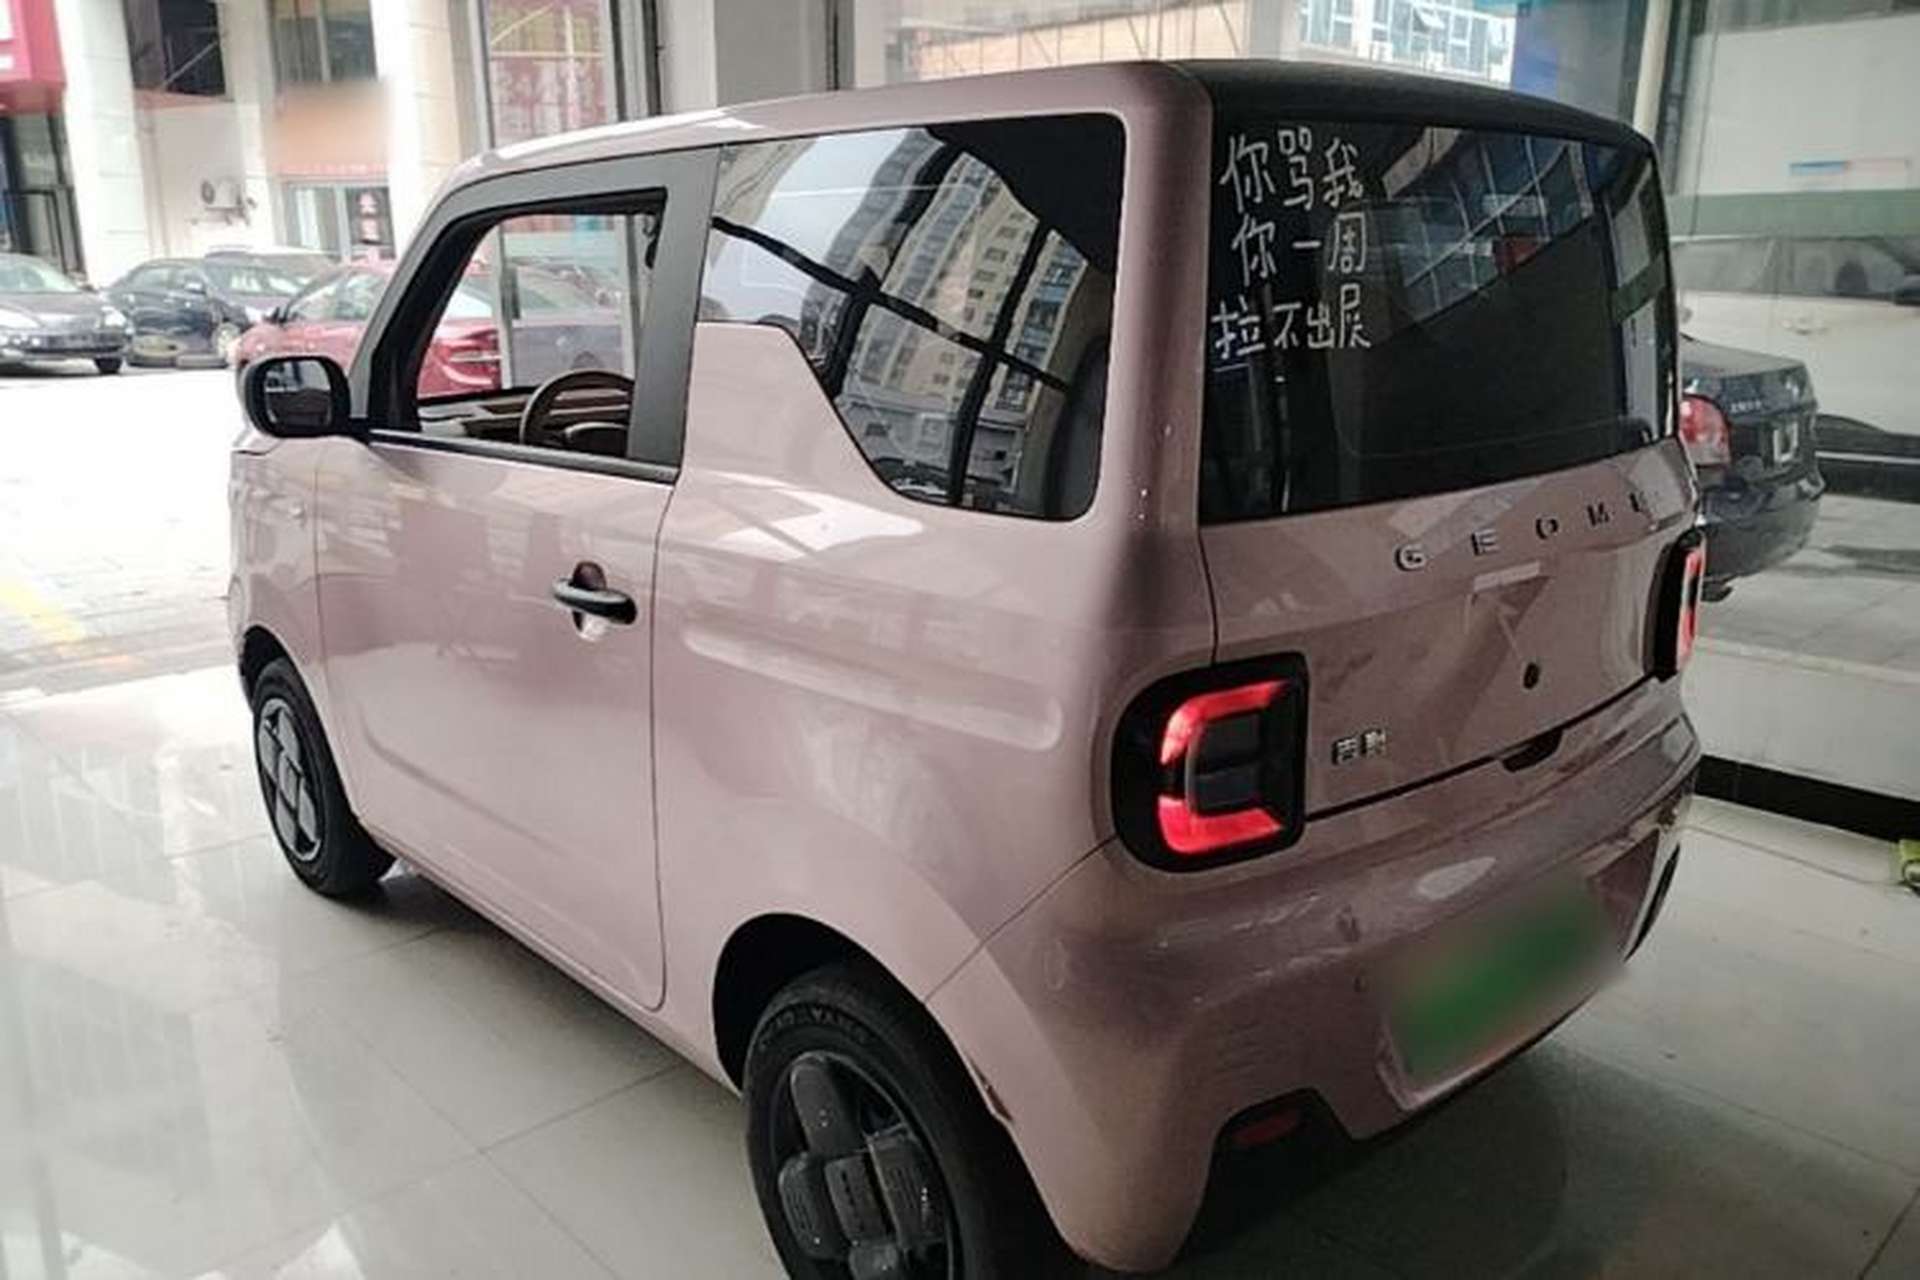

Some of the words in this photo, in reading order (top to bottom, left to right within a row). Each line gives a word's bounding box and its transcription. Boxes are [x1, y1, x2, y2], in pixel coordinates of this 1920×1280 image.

[1218, 127, 1364, 214] 你骂我
[1231, 212, 1367, 287] 你一周
